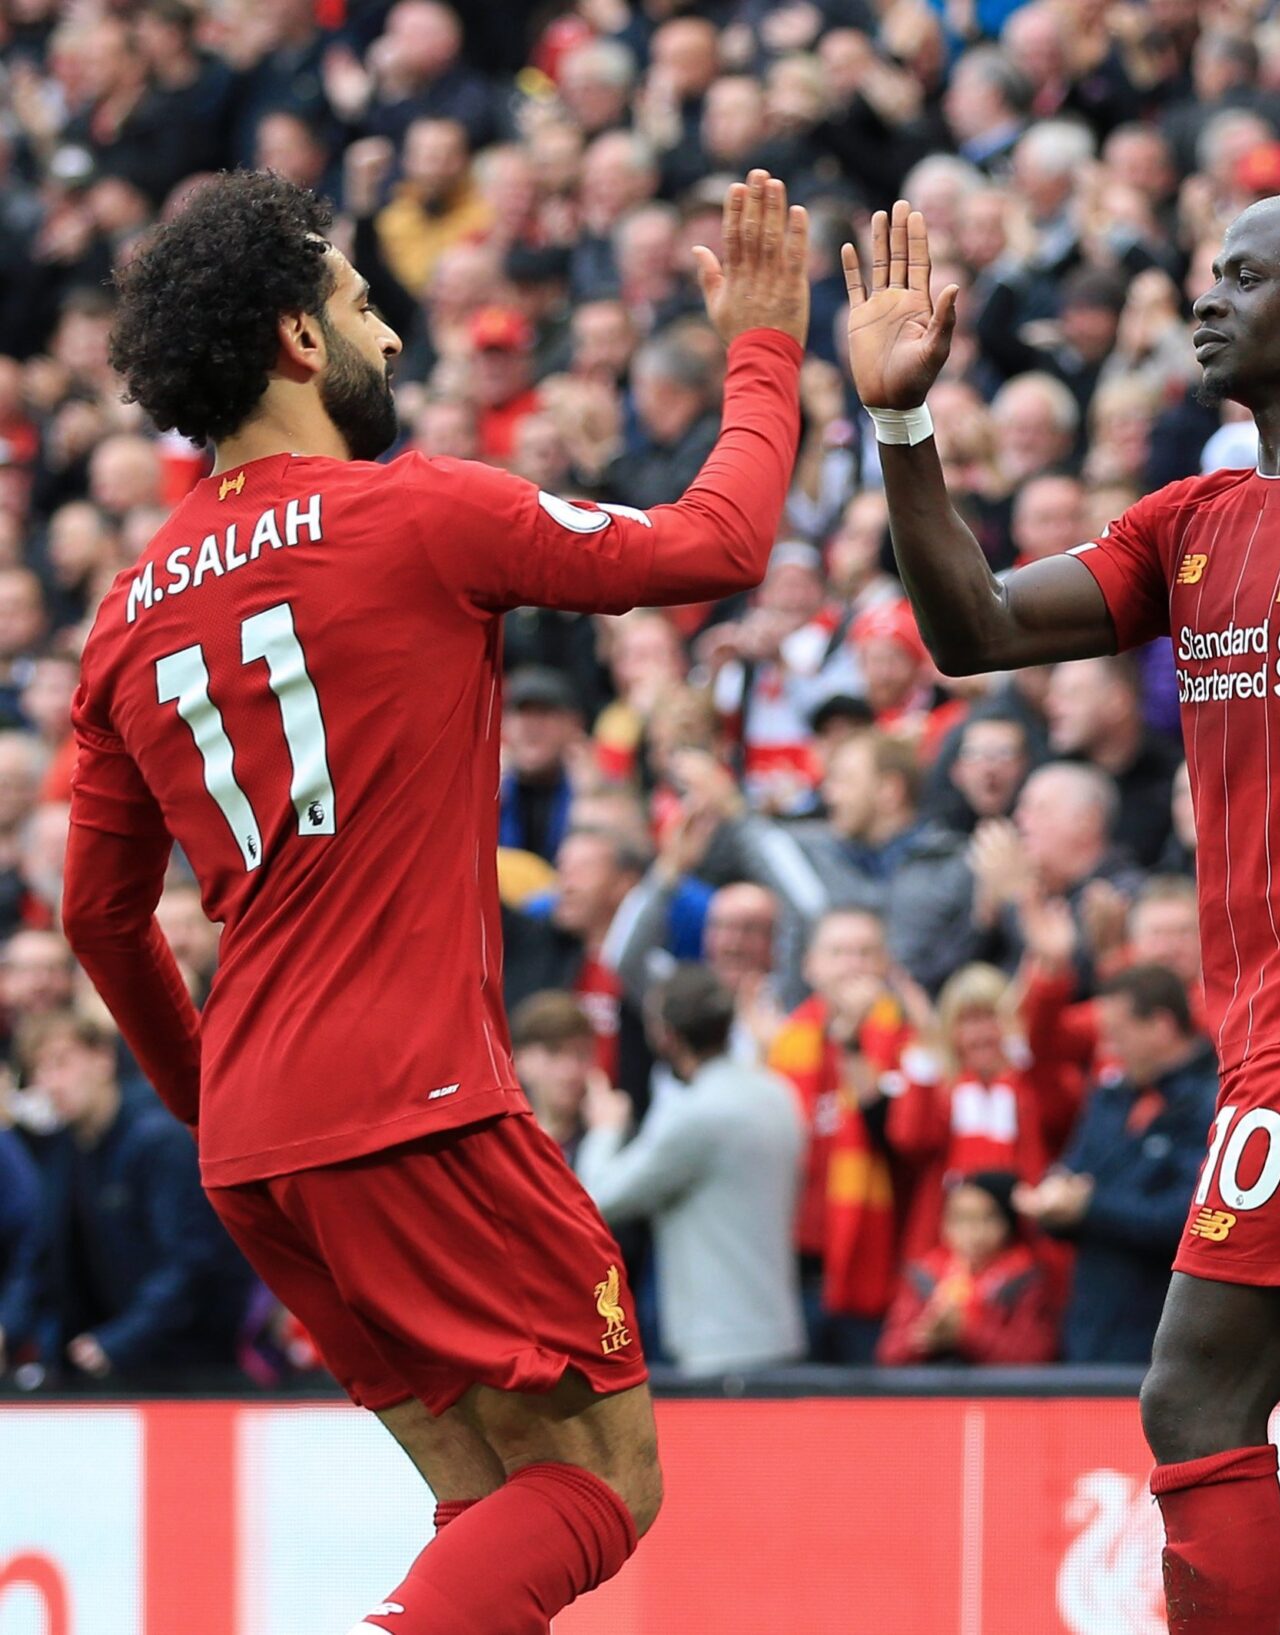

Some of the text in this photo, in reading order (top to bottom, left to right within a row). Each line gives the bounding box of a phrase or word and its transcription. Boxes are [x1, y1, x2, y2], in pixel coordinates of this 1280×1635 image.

[126, 493, 323, 624] M.SALAH
[1178, 618, 1268, 661] Standard
[154, 601, 337, 873] 11
